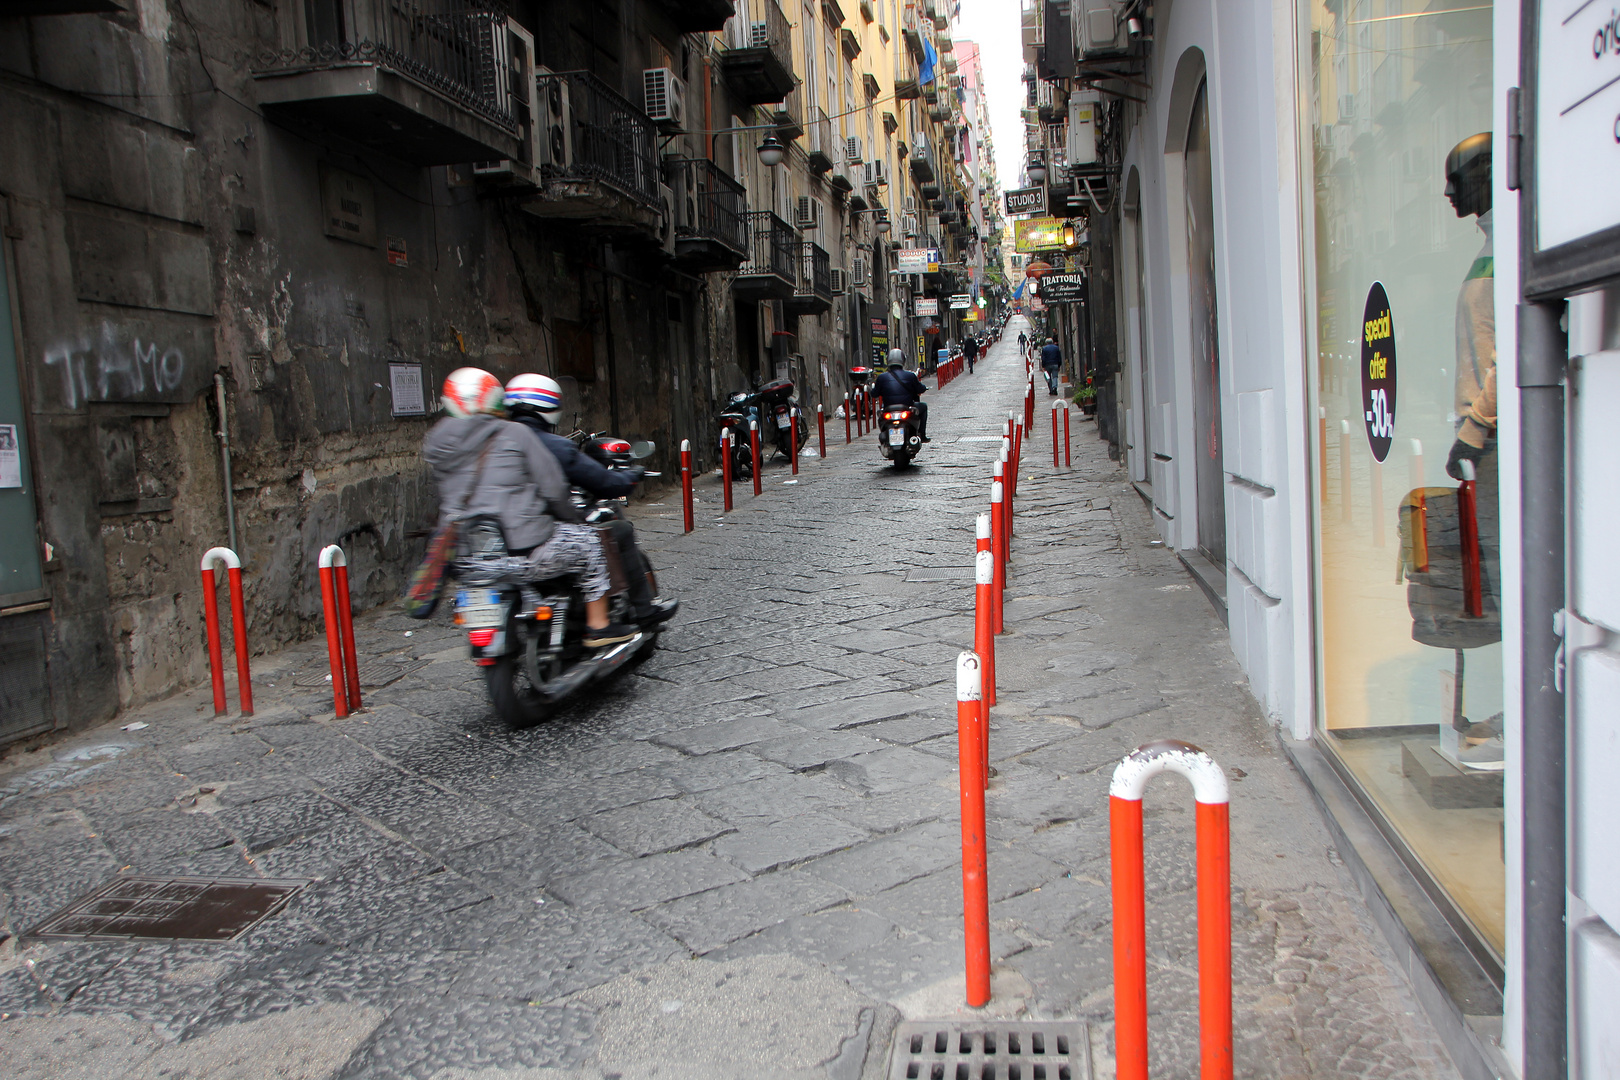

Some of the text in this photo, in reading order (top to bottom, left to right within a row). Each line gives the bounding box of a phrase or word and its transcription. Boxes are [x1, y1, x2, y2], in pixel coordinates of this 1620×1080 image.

[1008, 193, 1041, 207] STUDIO 3
[1020, 219, 1063, 227] Ristorante
[928, 250, 936, 262] T
[1042, 274, 1082, 287] TRATTORIA
[1365, 309, 1391, 347] special
[1370, 352, 1387, 379] offer
[1366, 388, 1393, 438] -30%
